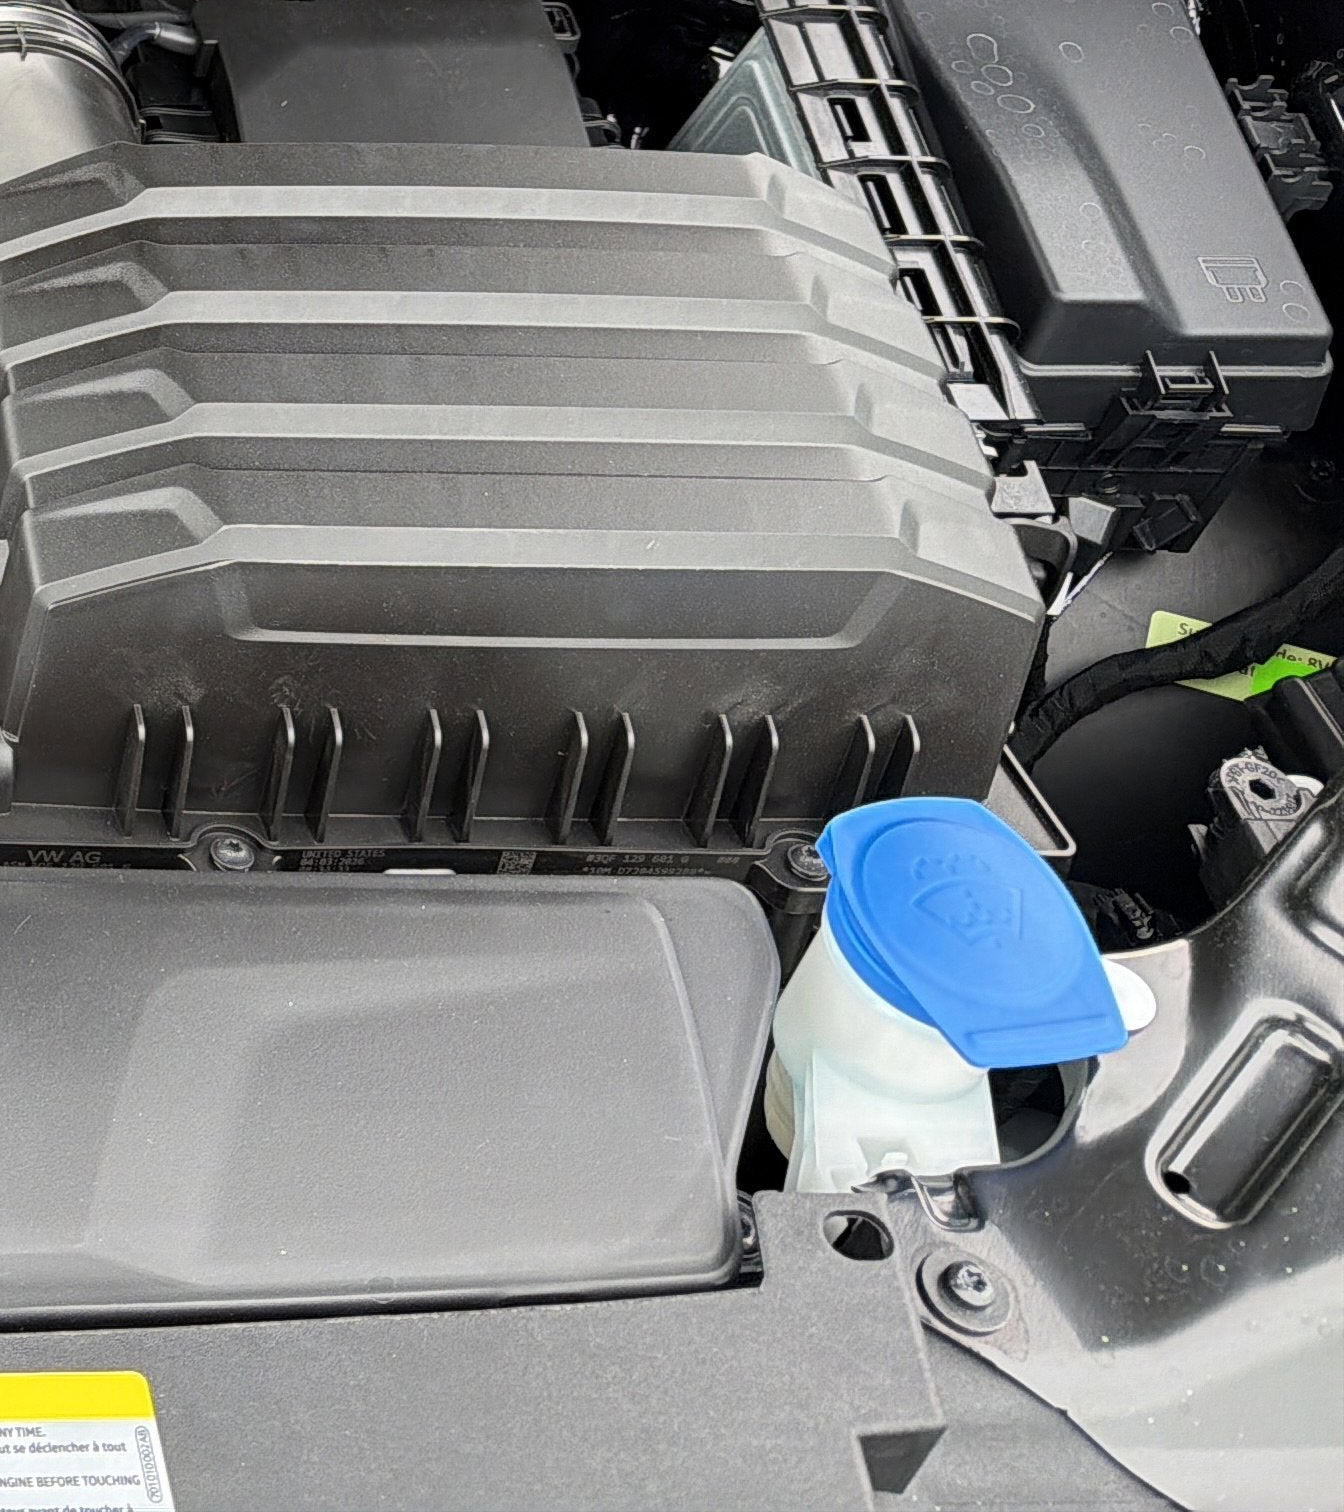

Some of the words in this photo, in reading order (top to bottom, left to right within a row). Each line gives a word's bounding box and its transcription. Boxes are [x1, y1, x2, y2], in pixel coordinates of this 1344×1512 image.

[27, 849, 65, 862] VW
[69, 851, 102, 864] AG
[302, 850, 341, 858] UNITED
[15, 1426, 47, 1438] TIME.
[13, 1445, 26, 1454] se
[28, 1442, 90, 1454] déclencher
[102, 1442, 127, 1452] tout
[36, 1476, 80, 1488] BEFORE
[82, 1475, 141, 1487] TOUCHING
